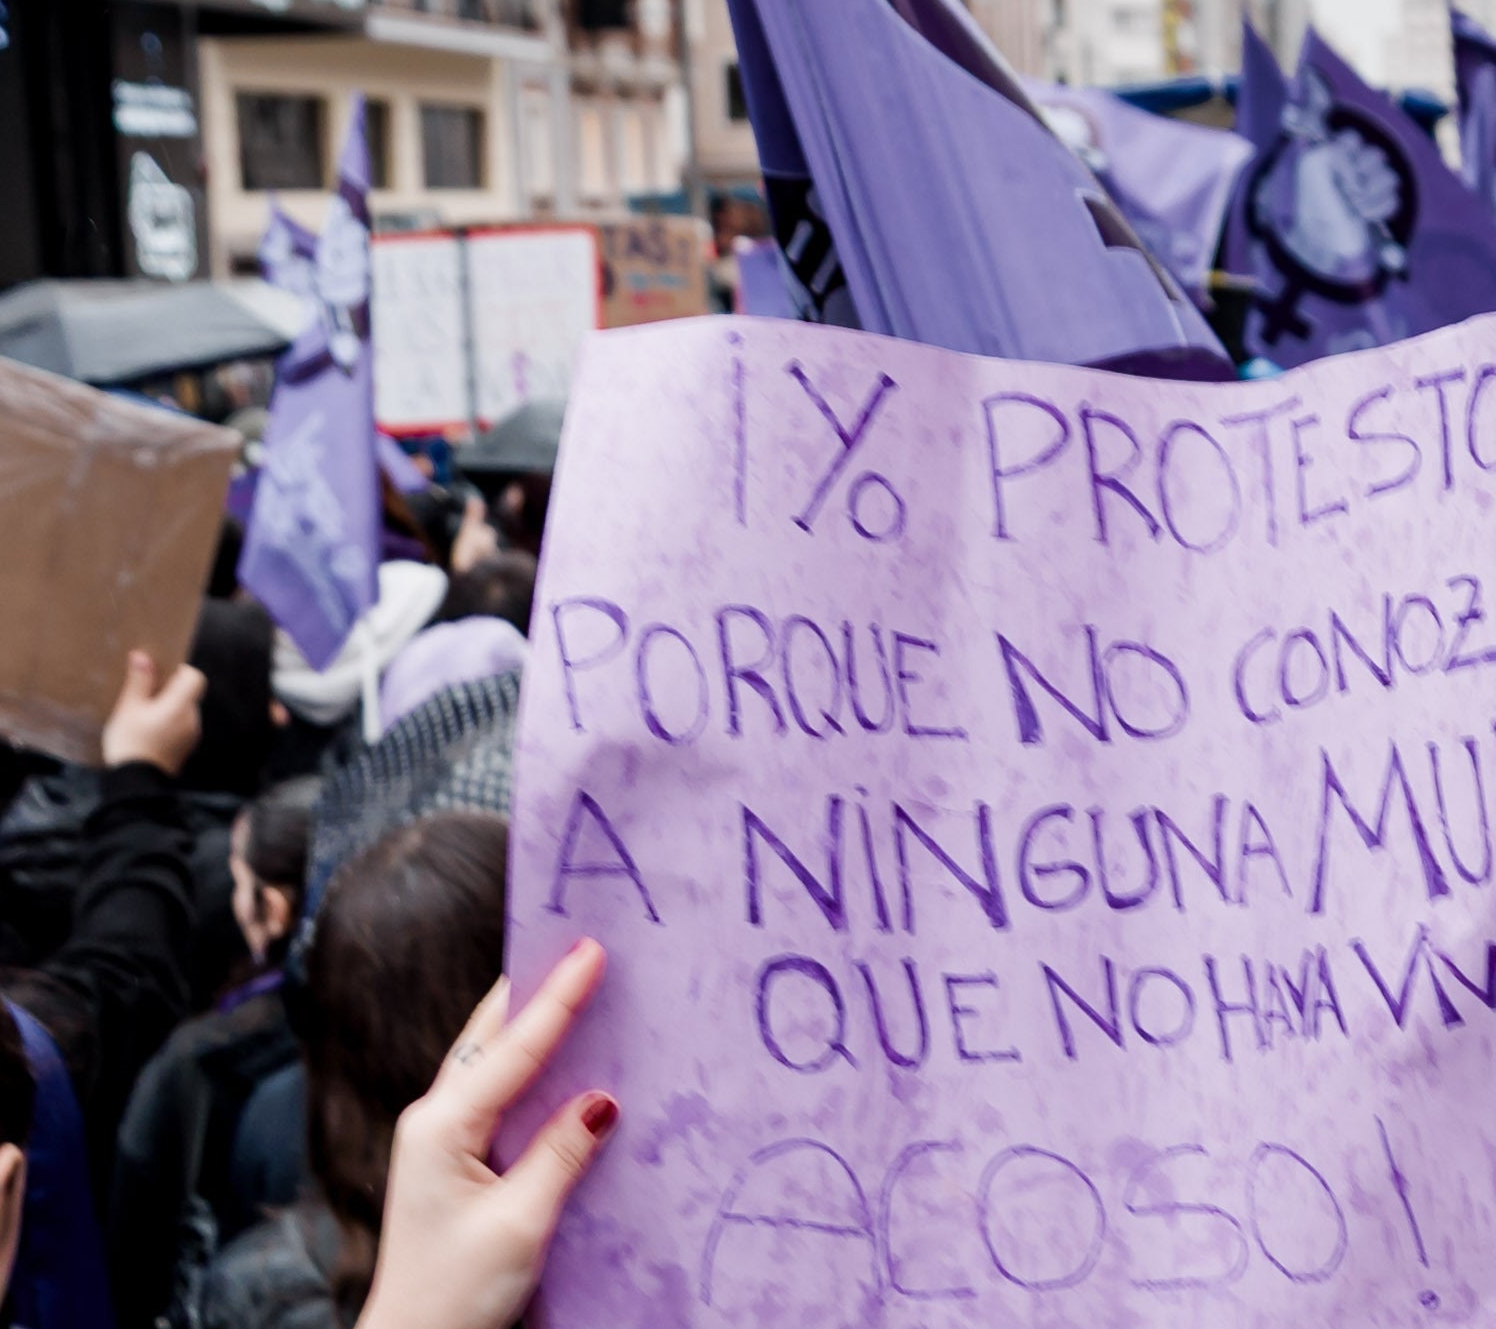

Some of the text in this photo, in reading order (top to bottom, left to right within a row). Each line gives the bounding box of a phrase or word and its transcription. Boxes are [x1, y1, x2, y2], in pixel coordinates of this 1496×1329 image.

[548, 596, 968, 747] PORQUE
[996, 623, 1190, 745] NO
[545, 788, 661, 926] A
[754, 951, 1023, 1073] QUE
[1040, 951, 1198, 1061] NO
